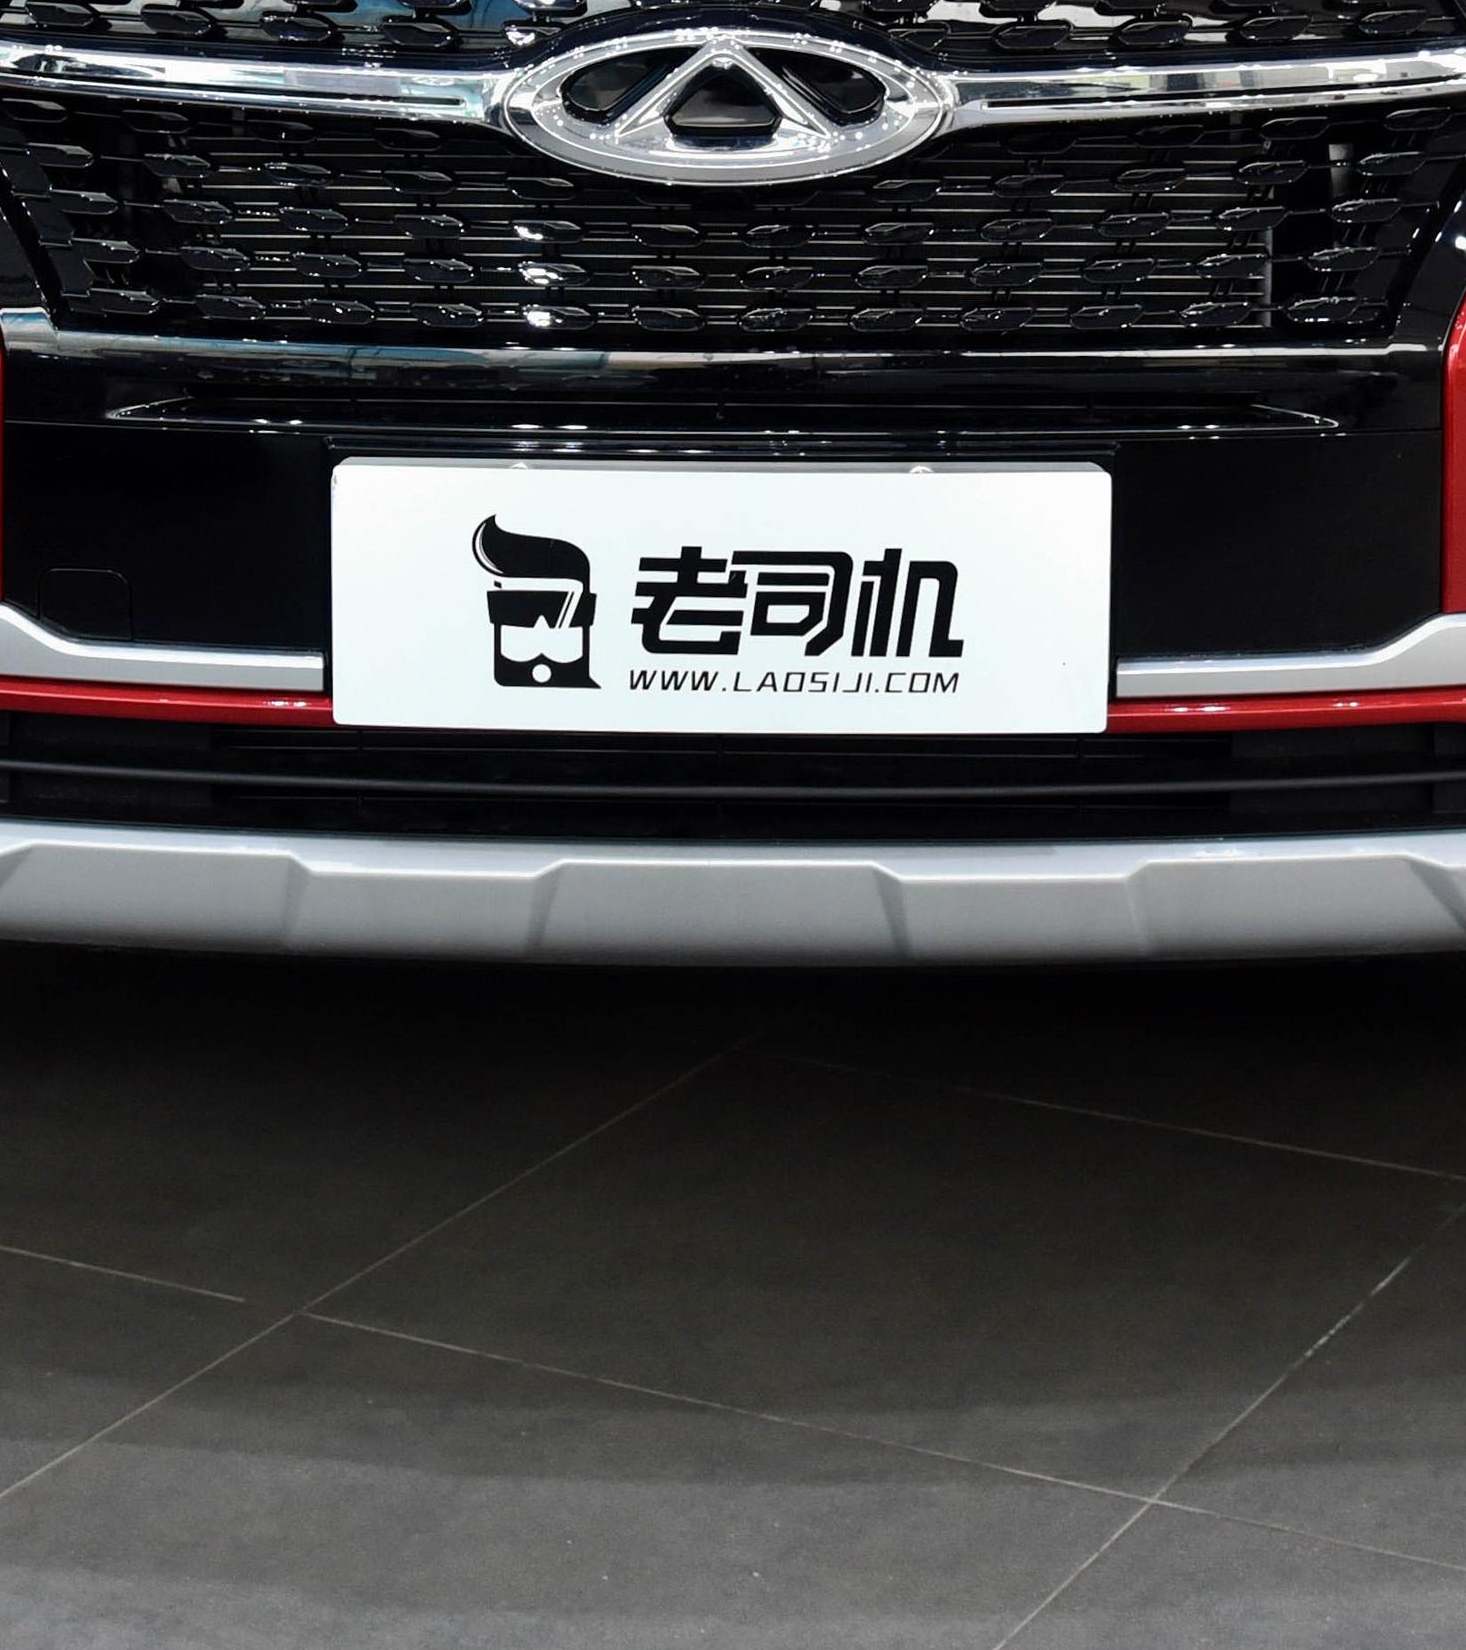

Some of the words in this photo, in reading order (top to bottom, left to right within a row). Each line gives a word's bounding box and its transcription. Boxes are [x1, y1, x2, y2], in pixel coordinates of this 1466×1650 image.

[630, 546, 964, 657] 老司机
[629, 669, 960, 695] WWW.LAOSIJI.COM
